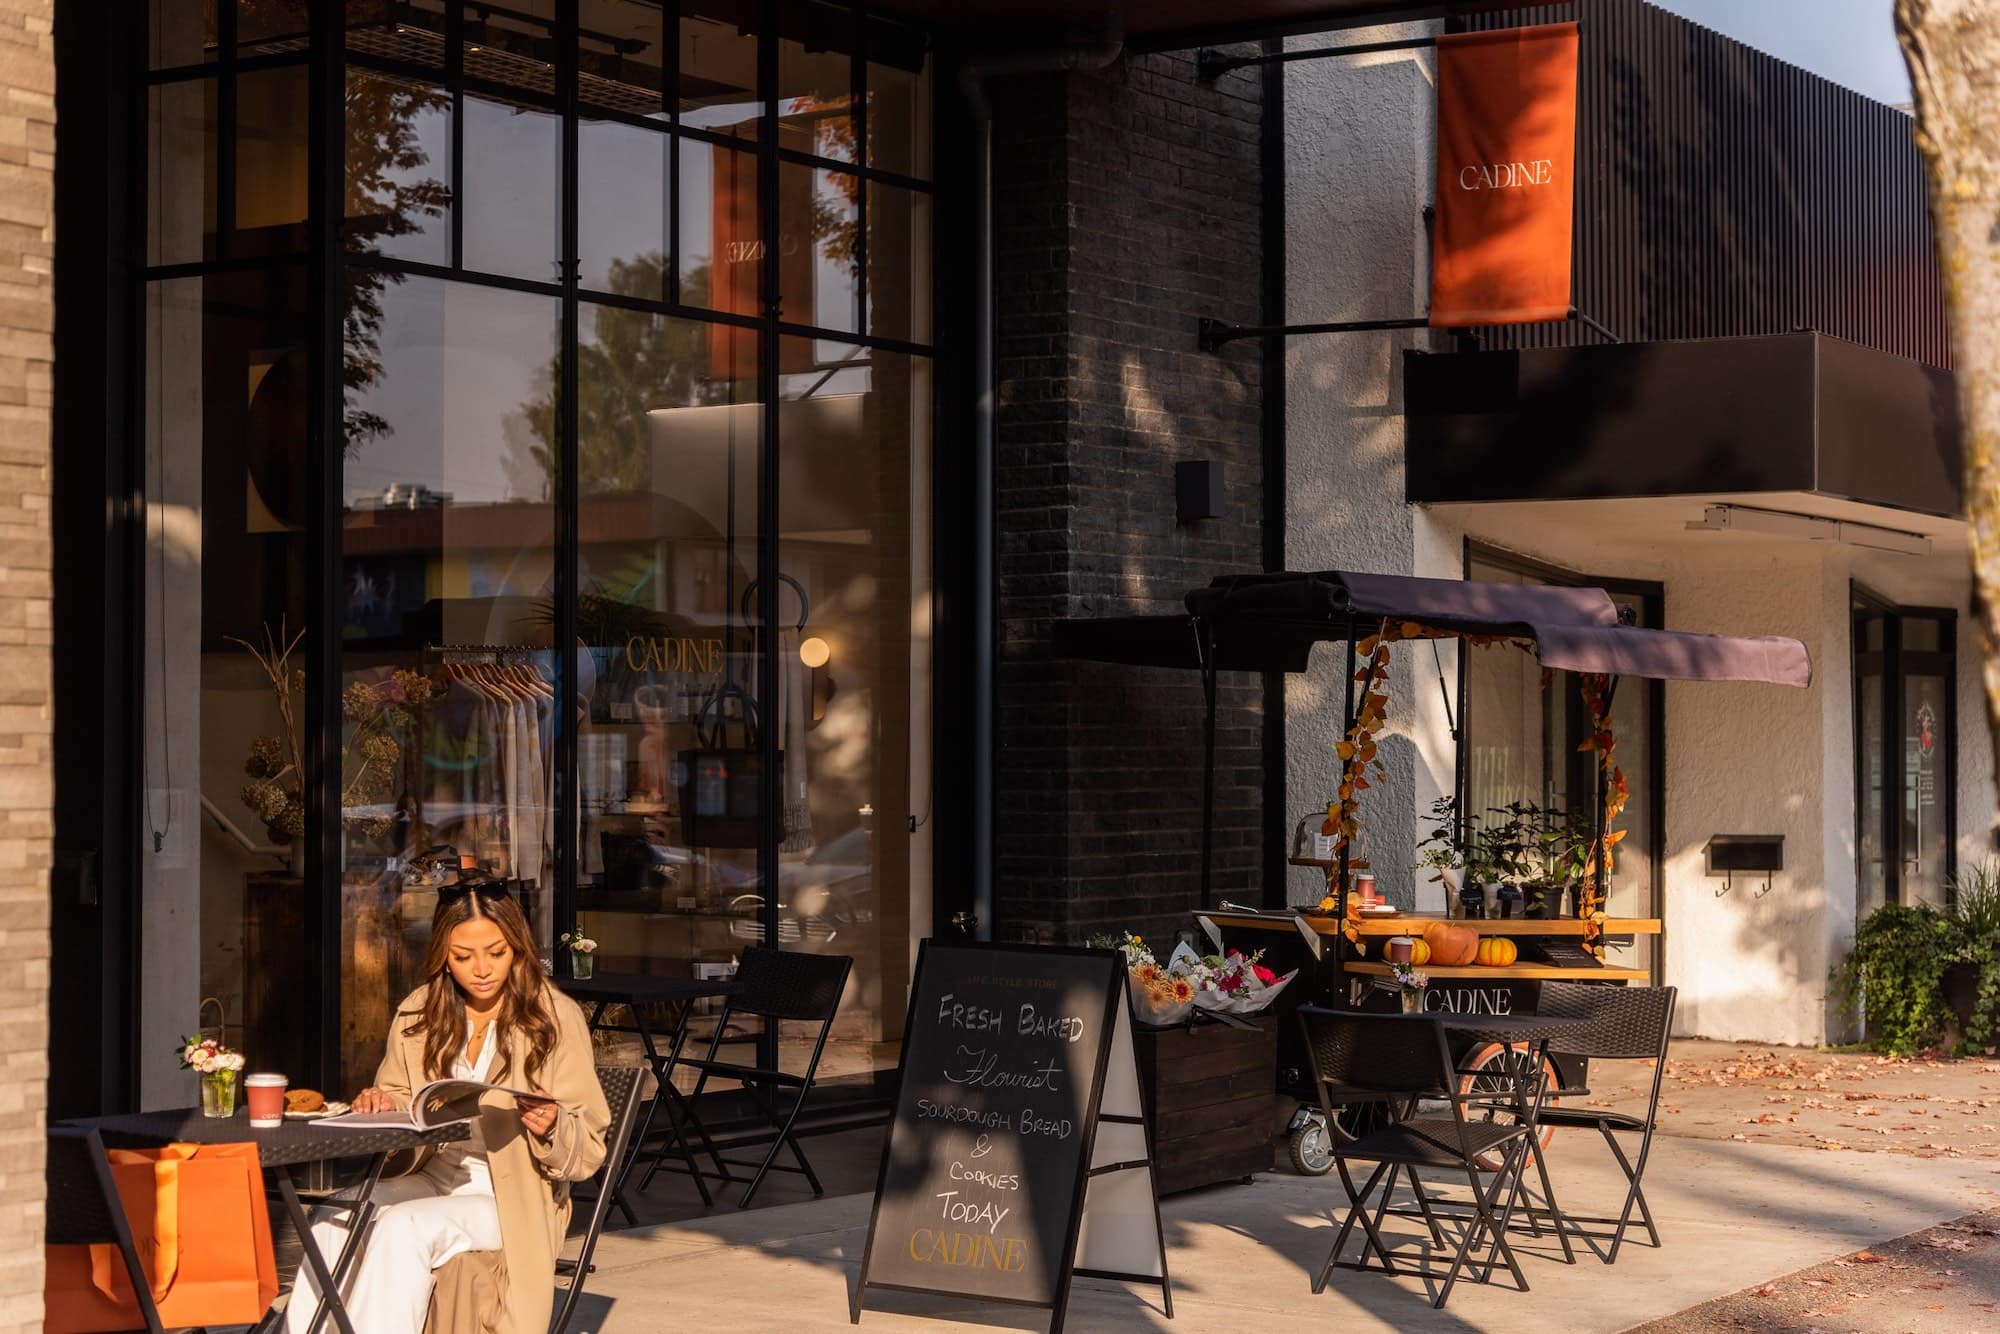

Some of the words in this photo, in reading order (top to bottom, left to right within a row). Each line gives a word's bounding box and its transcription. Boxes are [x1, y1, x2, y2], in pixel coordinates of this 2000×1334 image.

[1459, 159, 1552, 191] CADINE
[626, 635, 724, 673] CADINE
[938, 993, 1003, 1035] FRESH
[1017, 1003, 1084, 1043] BAKED
[1424, 988, 1512, 1016] CADINE
[917, 1099, 1012, 1130] SOURDOUGH
[1020, 1108, 1072, 1140] BREAD
[970, 1133, 993, 1158] &
[950, 1161, 1019, 1190] COOKIES
[936, 1191, 1009, 1235] TODAY
[909, 1228, 1028, 1273] CADINE
